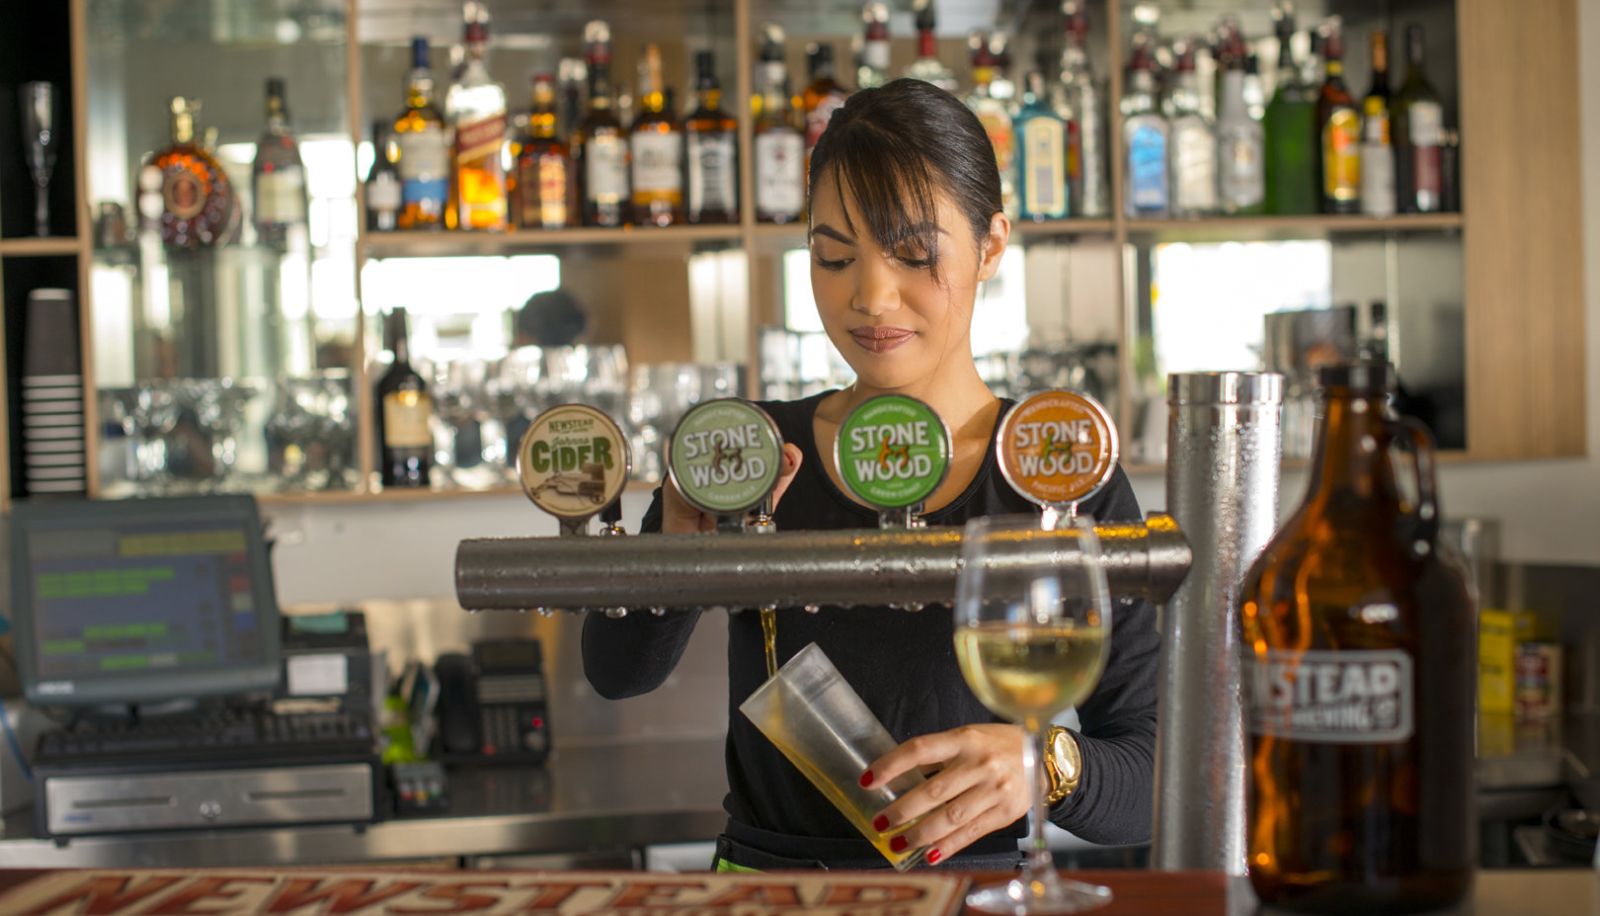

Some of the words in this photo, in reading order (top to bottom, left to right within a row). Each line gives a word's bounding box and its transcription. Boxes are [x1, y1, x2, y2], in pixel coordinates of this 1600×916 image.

[549, 419, 594, 433] NEWSTEAD
[683, 423, 762, 458] STONE
[851, 421, 930, 452] STONE
[1015, 420, 1092, 448] STONE
[532, 437, 614, 473] CIDER
[854, 454, 931, 482] WOOD
[1018, 452, 1093, 477] WOOD
[689, 456, 765, 488] WOOD
[26, 875, 926, 915] NEWSTEAD
